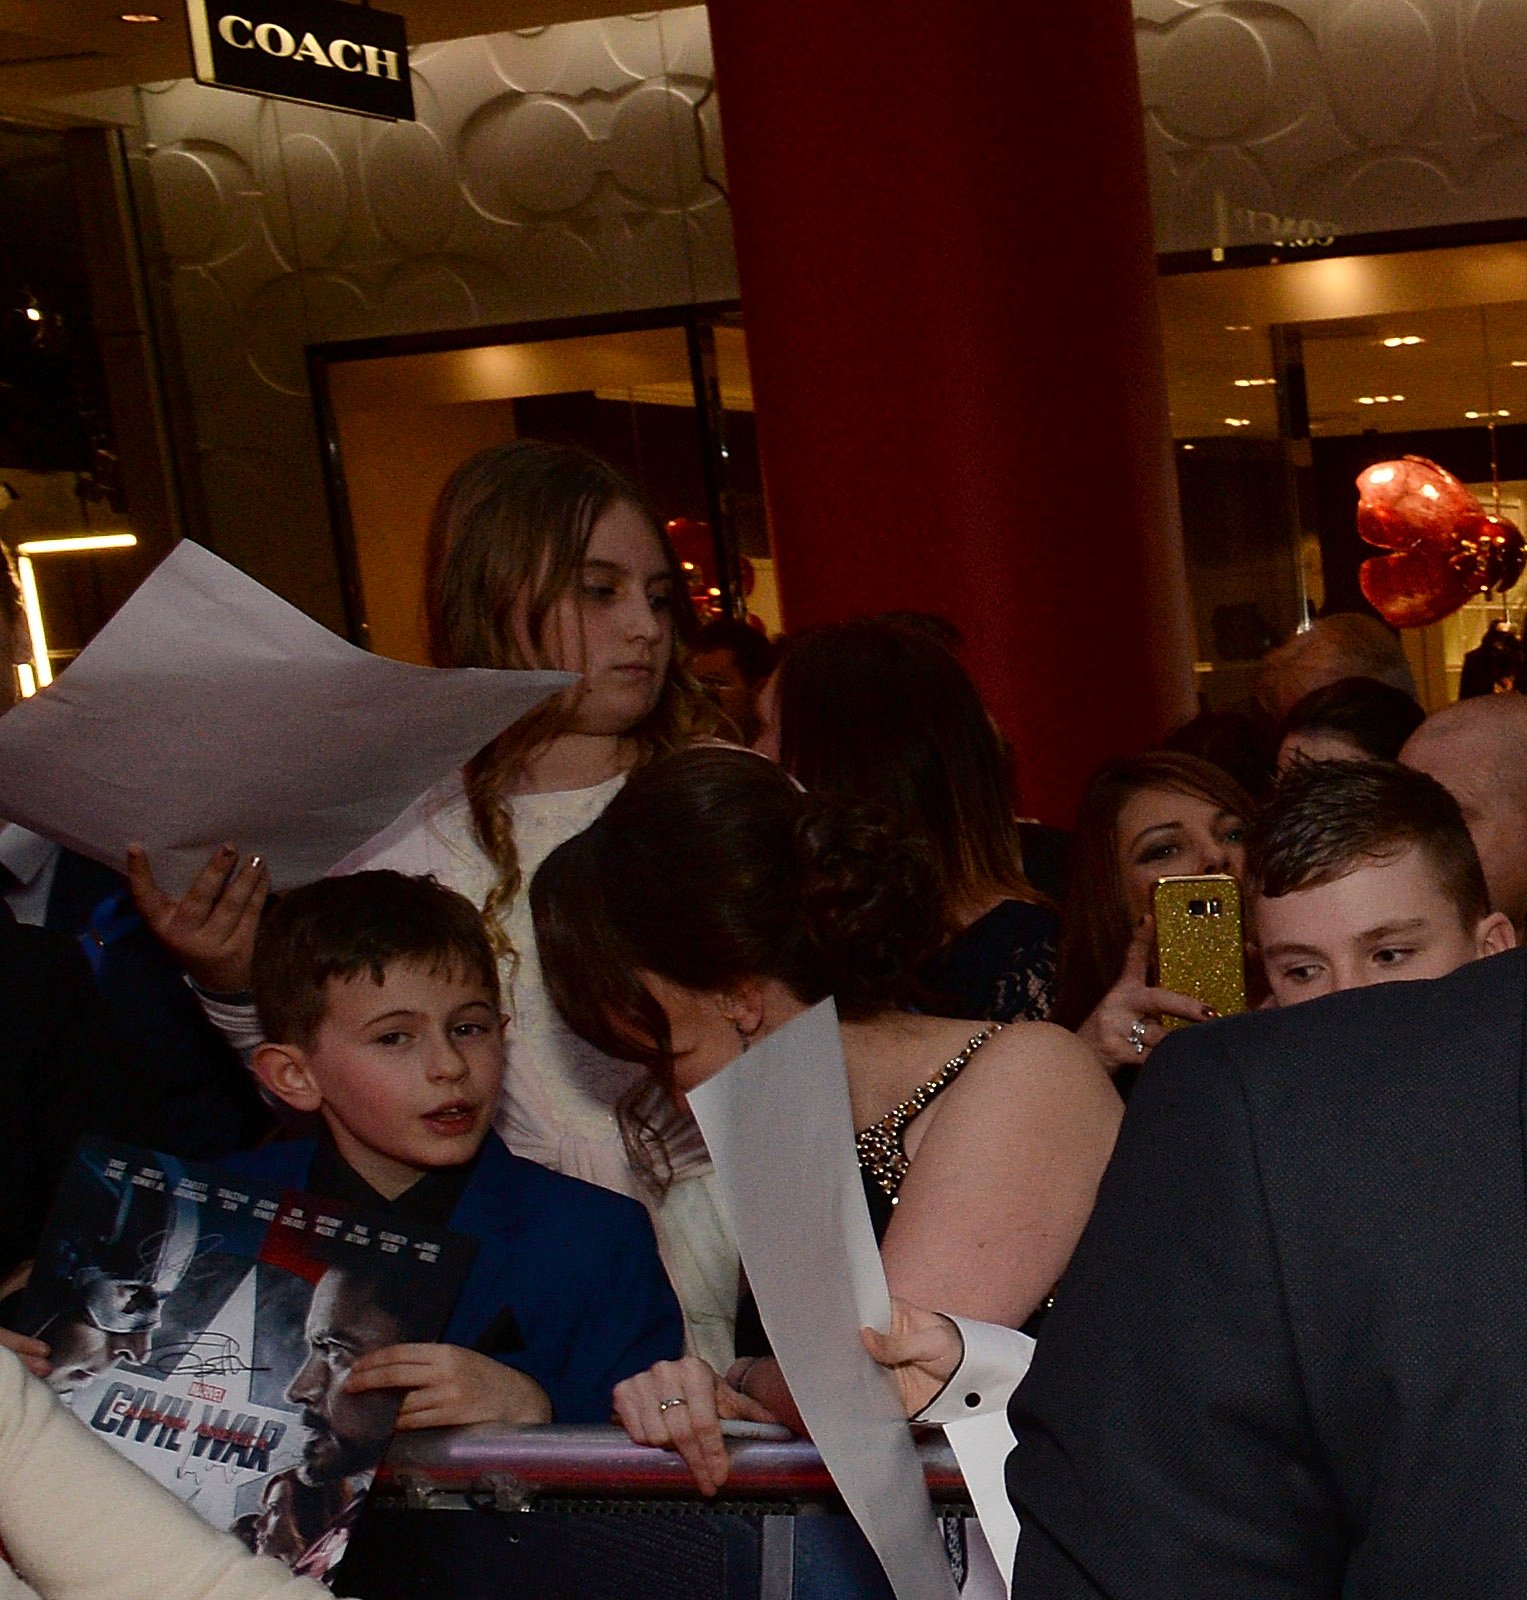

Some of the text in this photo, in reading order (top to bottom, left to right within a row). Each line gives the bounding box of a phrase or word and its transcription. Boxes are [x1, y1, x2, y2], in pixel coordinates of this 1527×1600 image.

[218, 14, 401, 82] COACH
[92, 1380, 287, 1474] CIVIL WAR
[113, 1400, 268, 1450] CAPTAIN AMERICA
